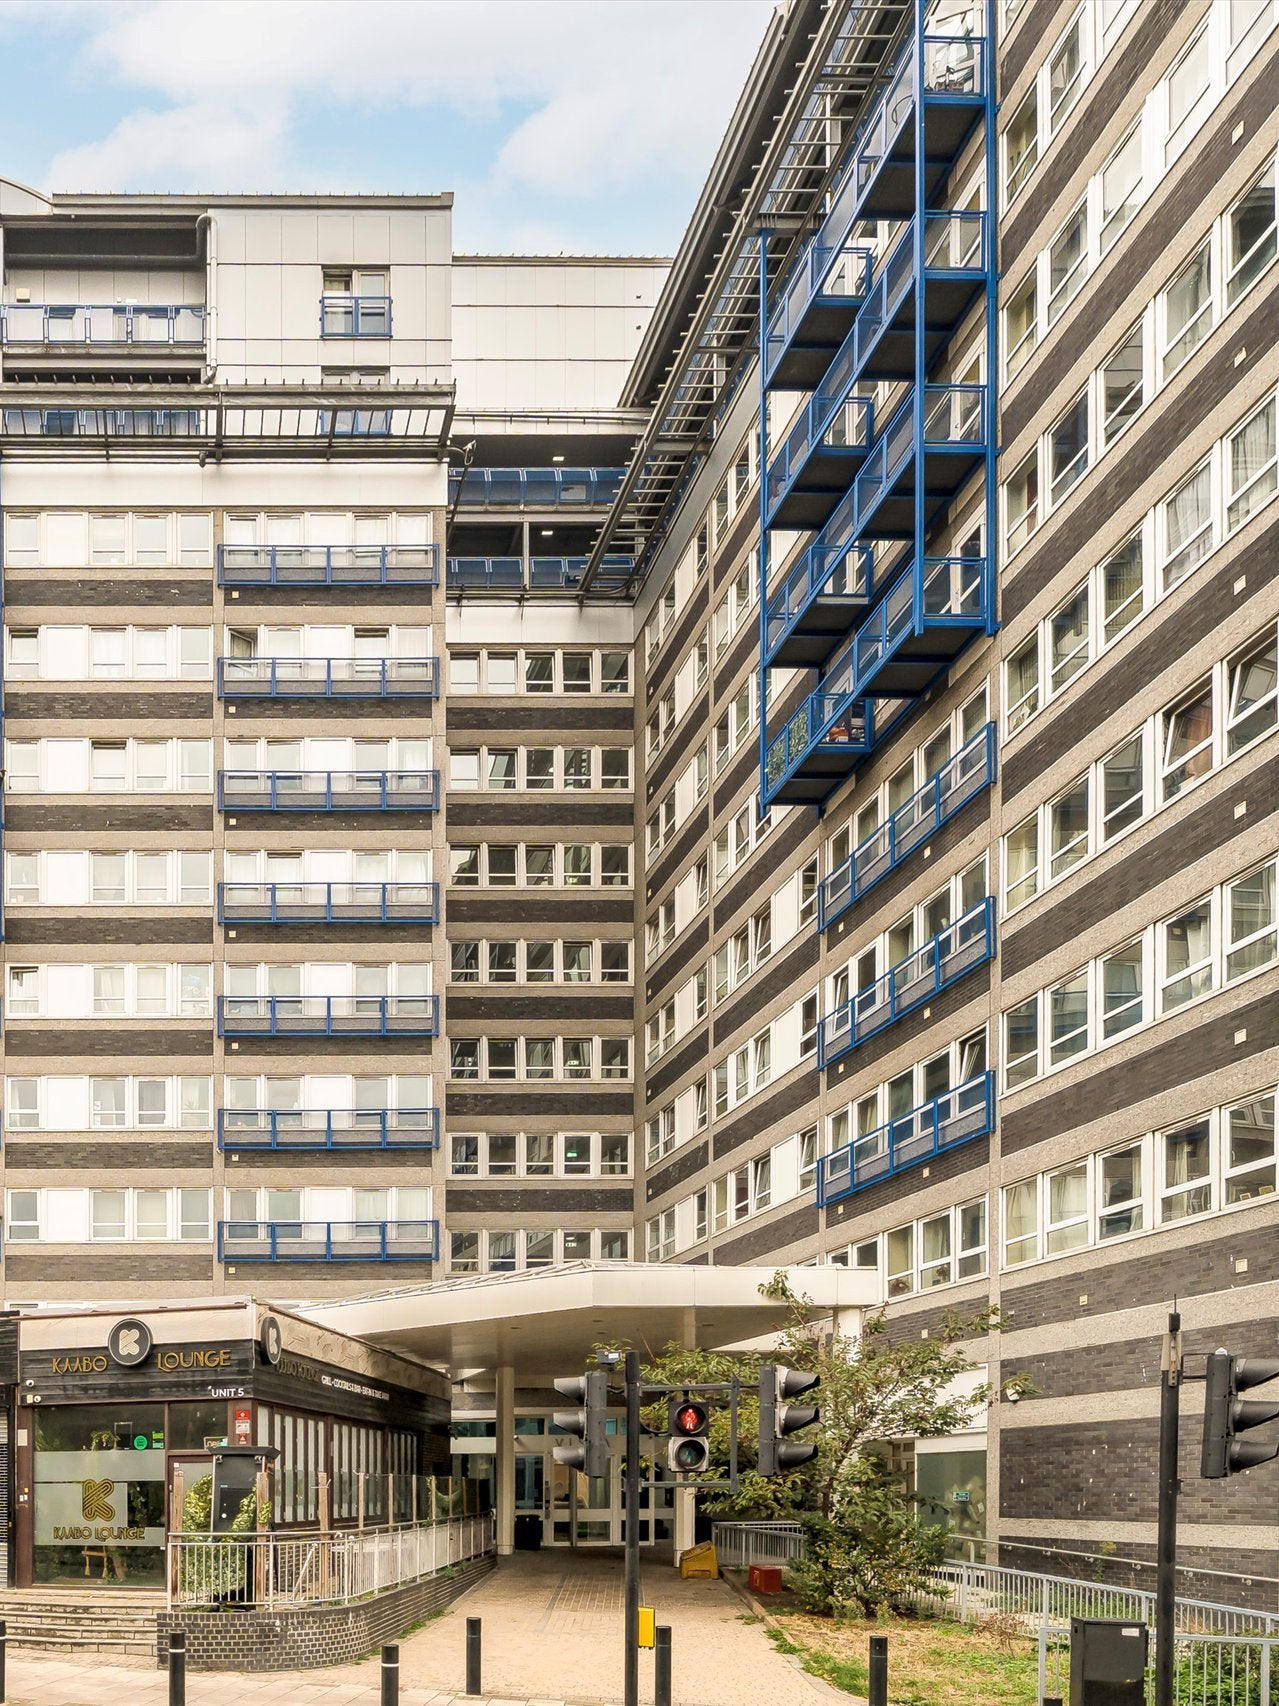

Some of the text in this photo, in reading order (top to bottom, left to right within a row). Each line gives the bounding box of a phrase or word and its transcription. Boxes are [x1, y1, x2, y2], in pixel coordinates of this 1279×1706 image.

[118, 1328, 140, 1356] K
[52, 1350, 231, 1375] KAABO LOUNGE
[211, 1388, 244, 1398] UNIT 5
[53, 1526, 145, 1542] KAABO LOUNGE
